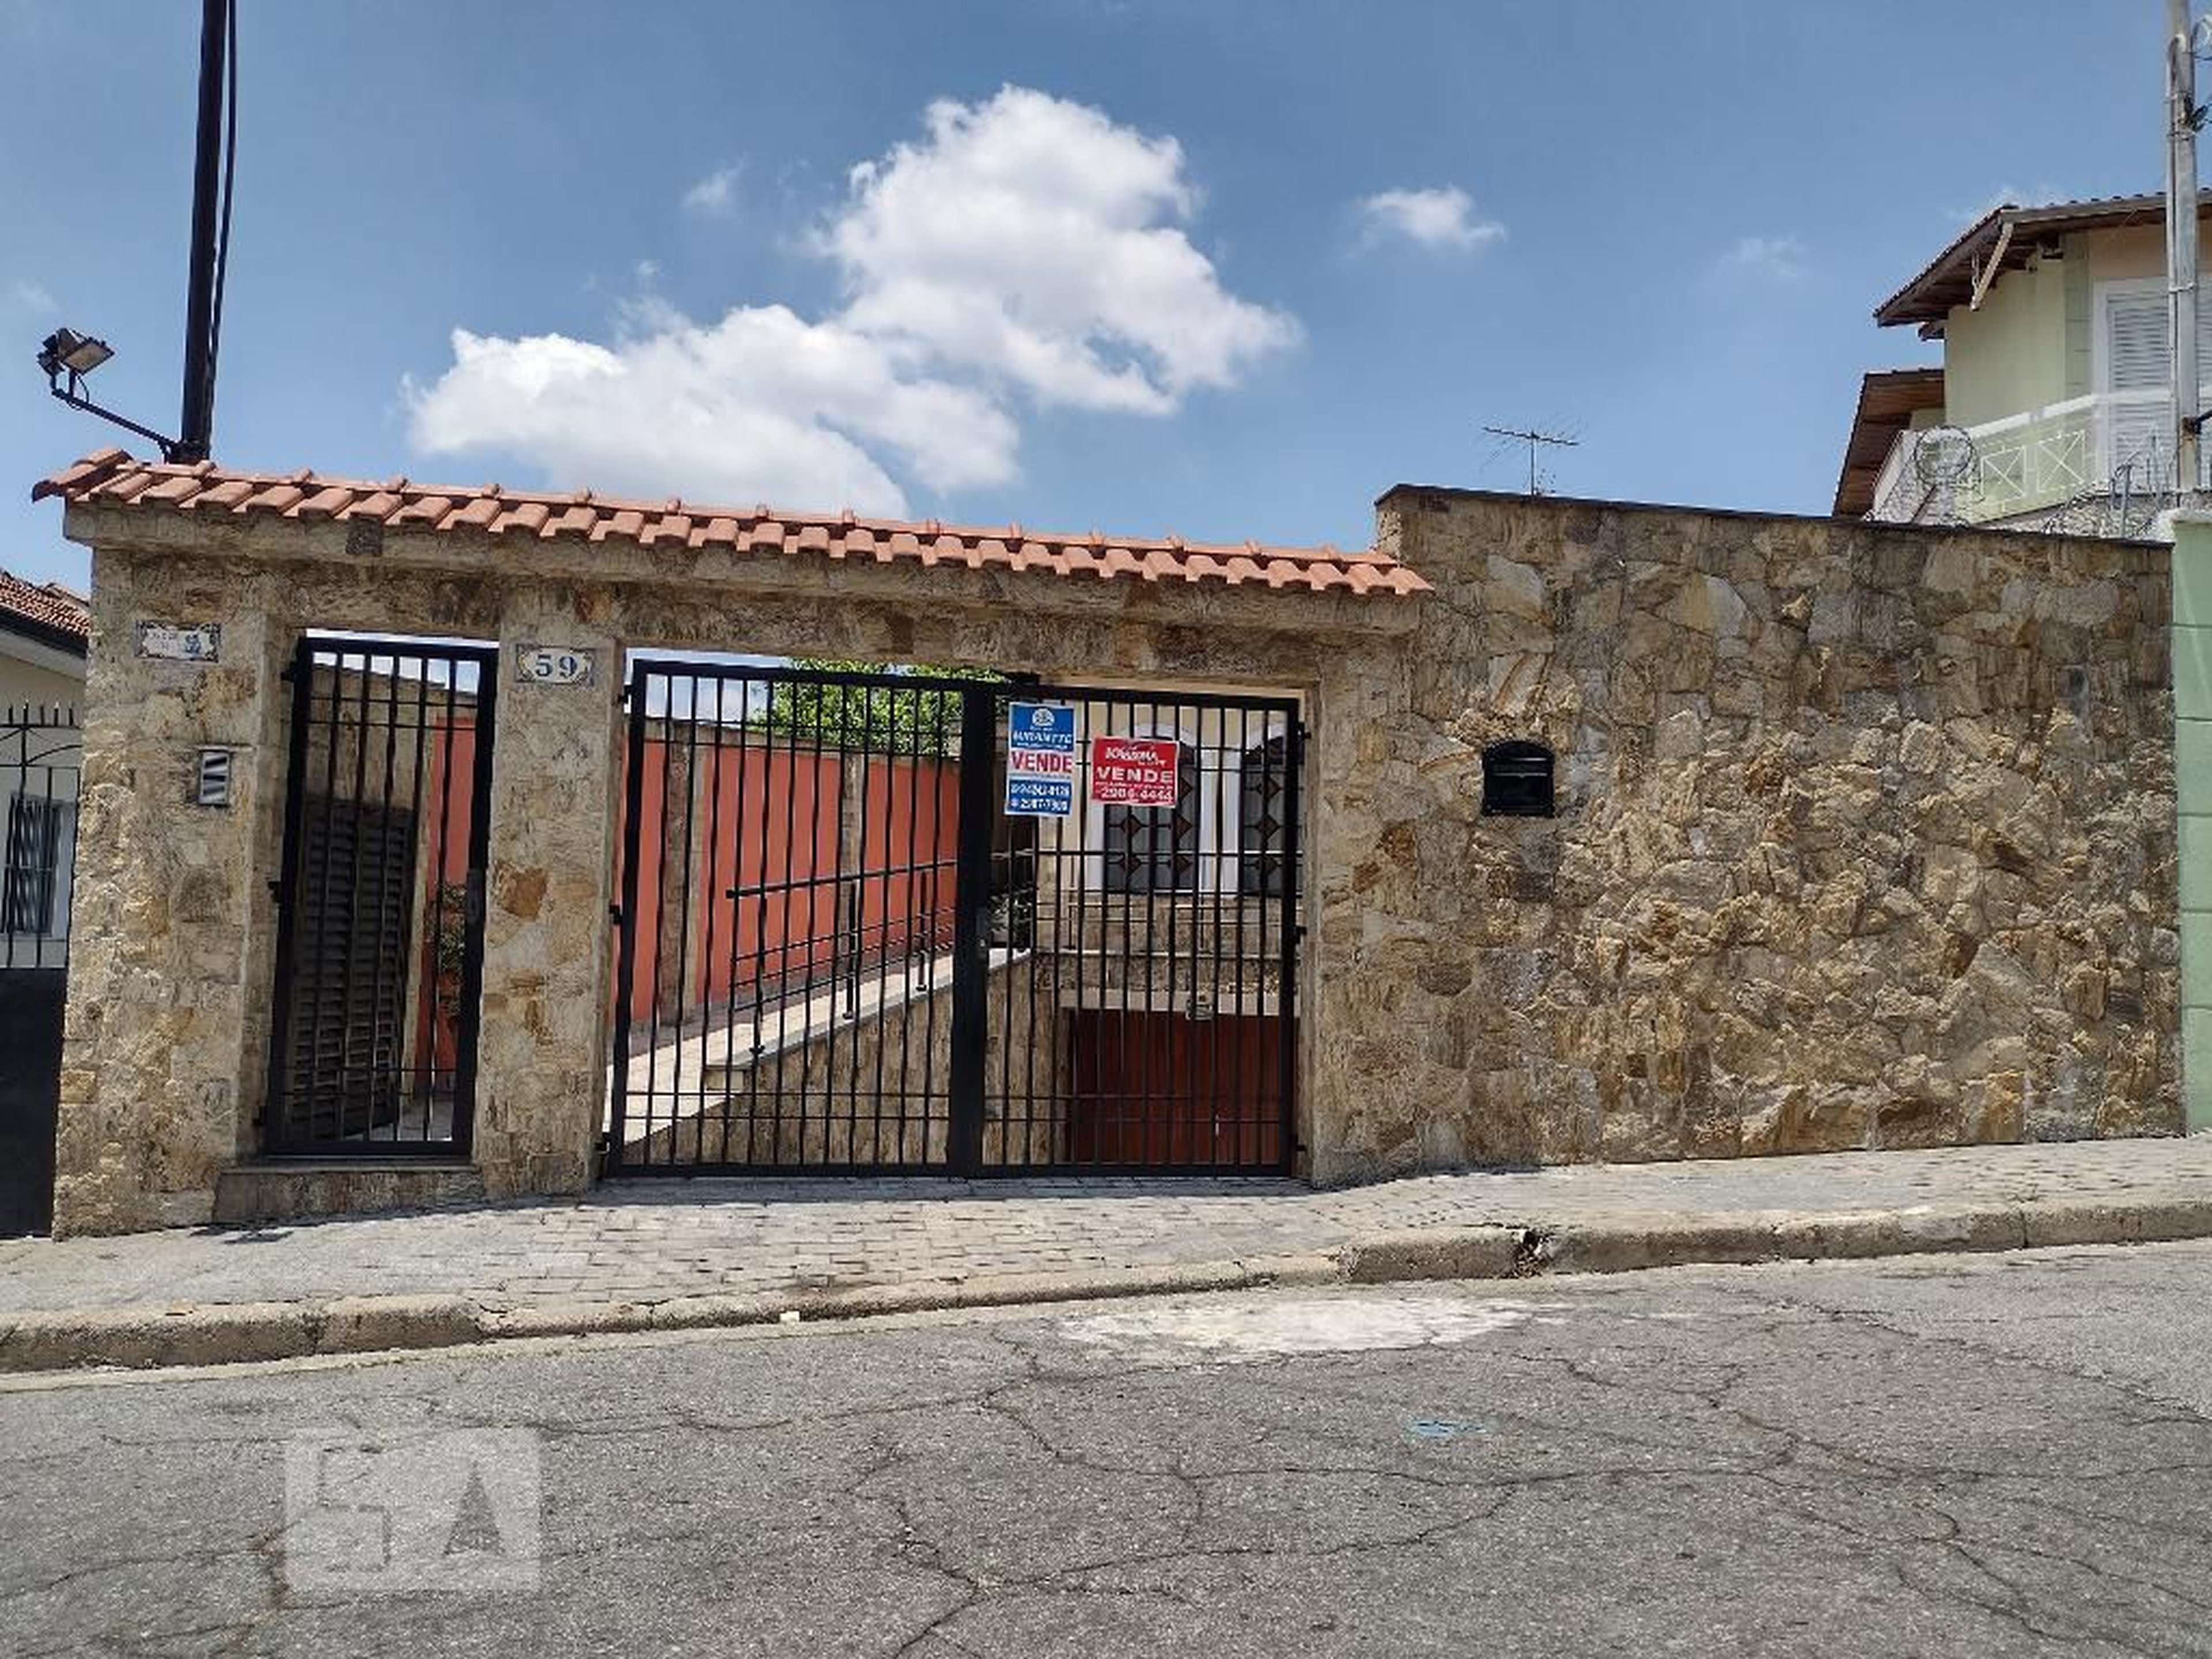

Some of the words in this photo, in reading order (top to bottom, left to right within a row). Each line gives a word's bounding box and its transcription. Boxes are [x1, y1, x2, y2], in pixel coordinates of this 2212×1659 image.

[536, 654, 577, 678] 59
[1011, 751, 1073, 774] VENDE
[1096, 766, 1174, 784] VENDE
